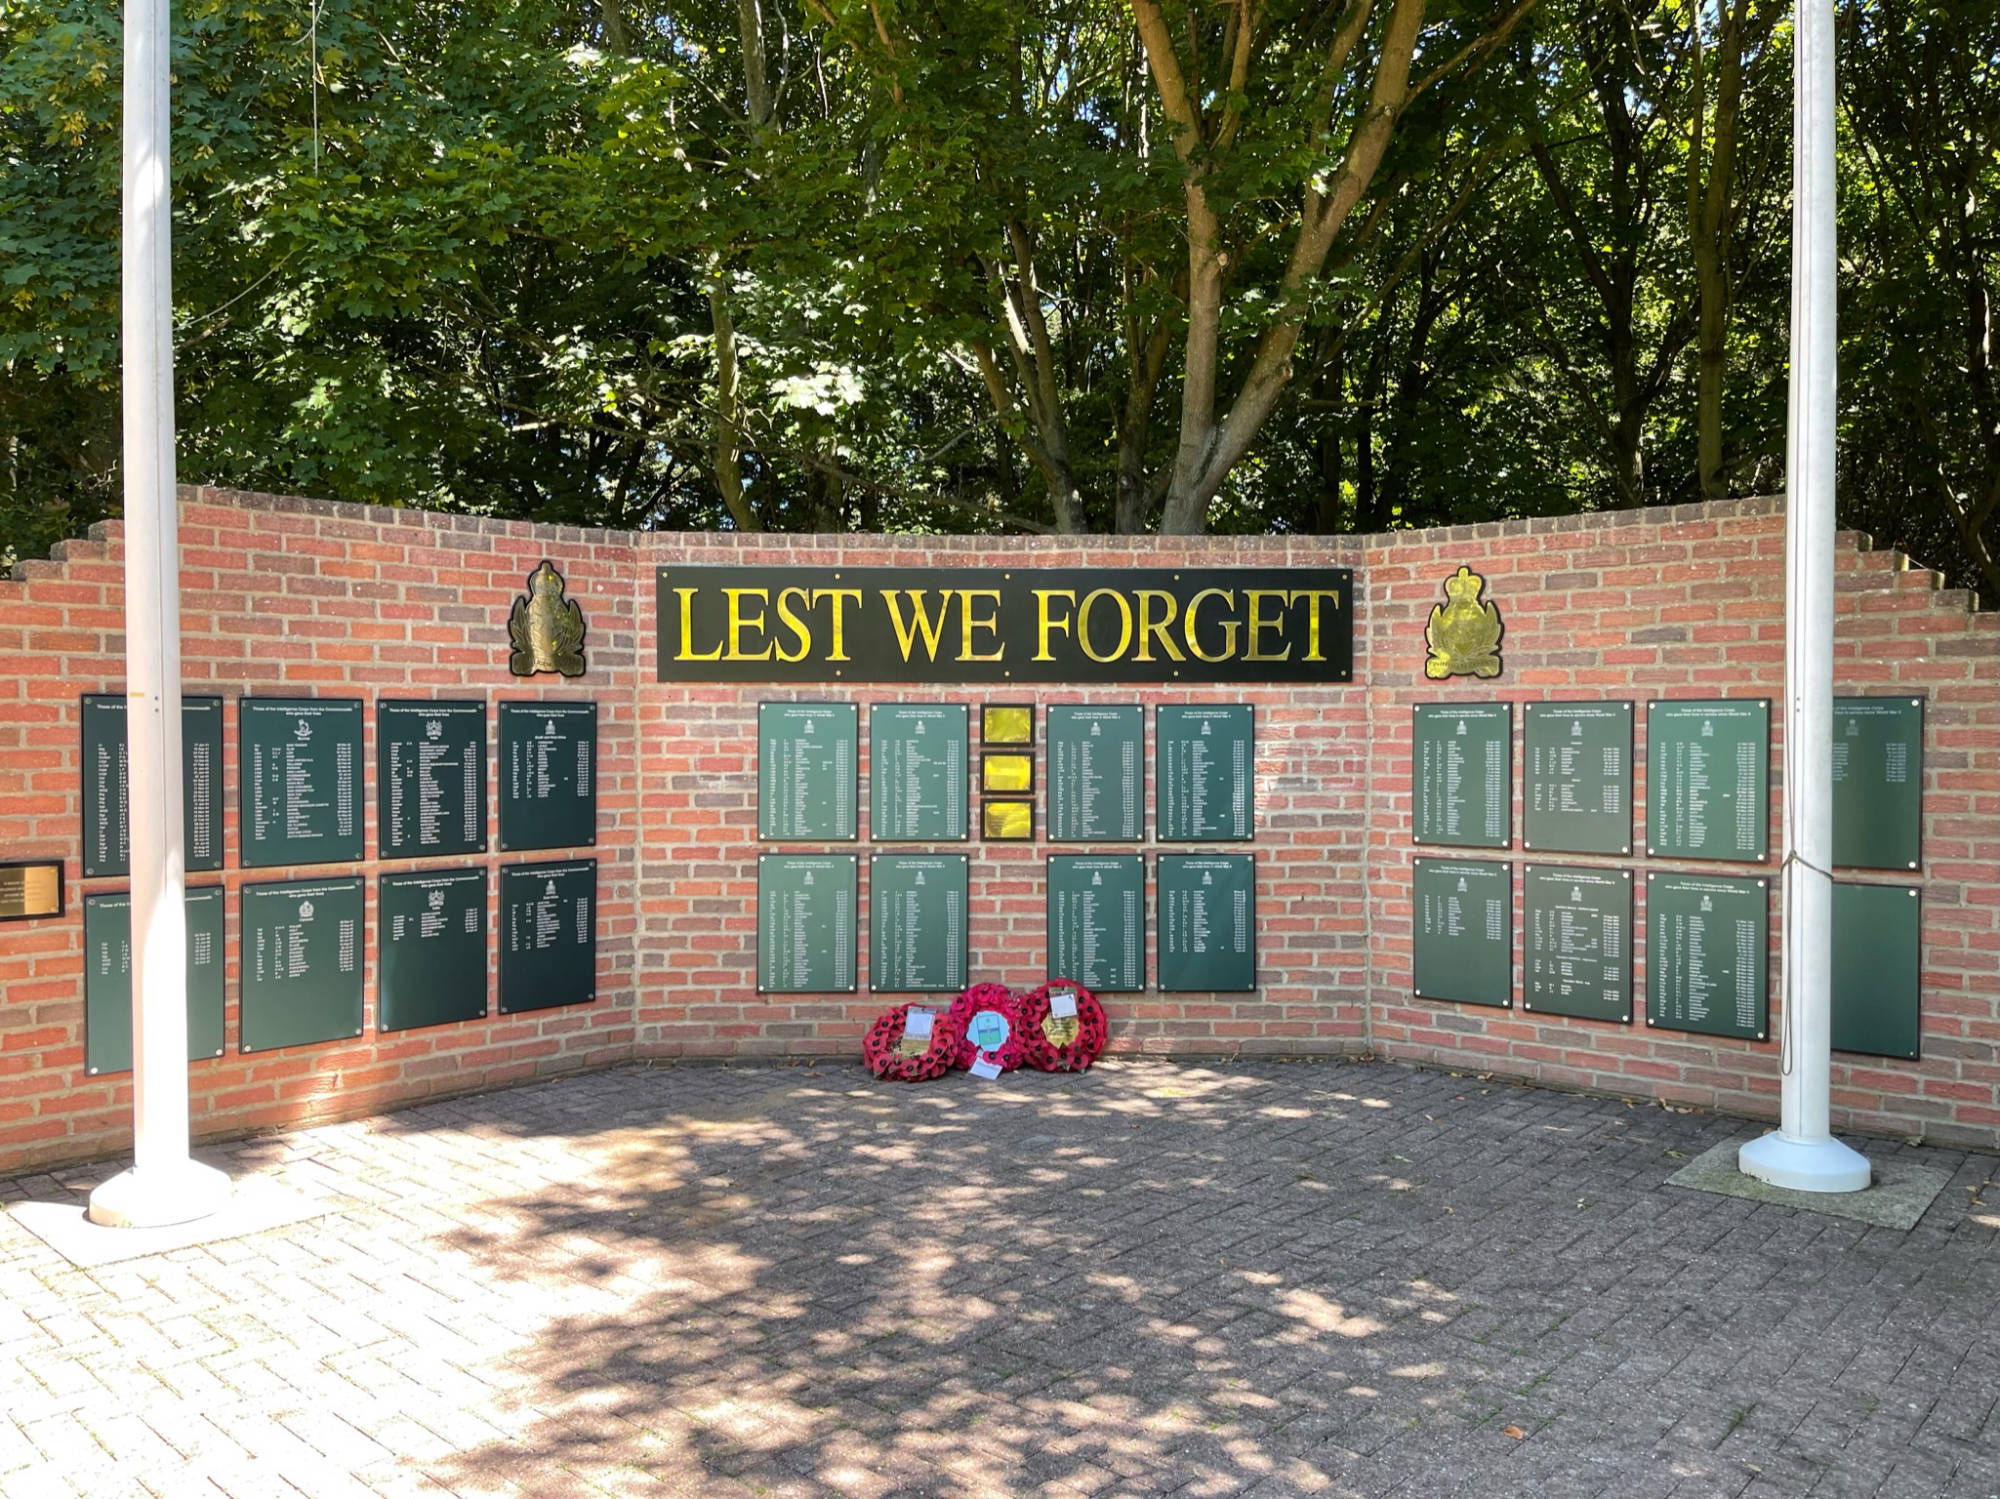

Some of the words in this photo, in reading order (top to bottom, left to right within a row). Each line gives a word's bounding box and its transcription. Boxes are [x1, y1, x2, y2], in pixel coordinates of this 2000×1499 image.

[672, 586, 863, 663] LEST
[880, 587, 1007, 664] WE
[1031, 587, 1340, 664] FORGET
